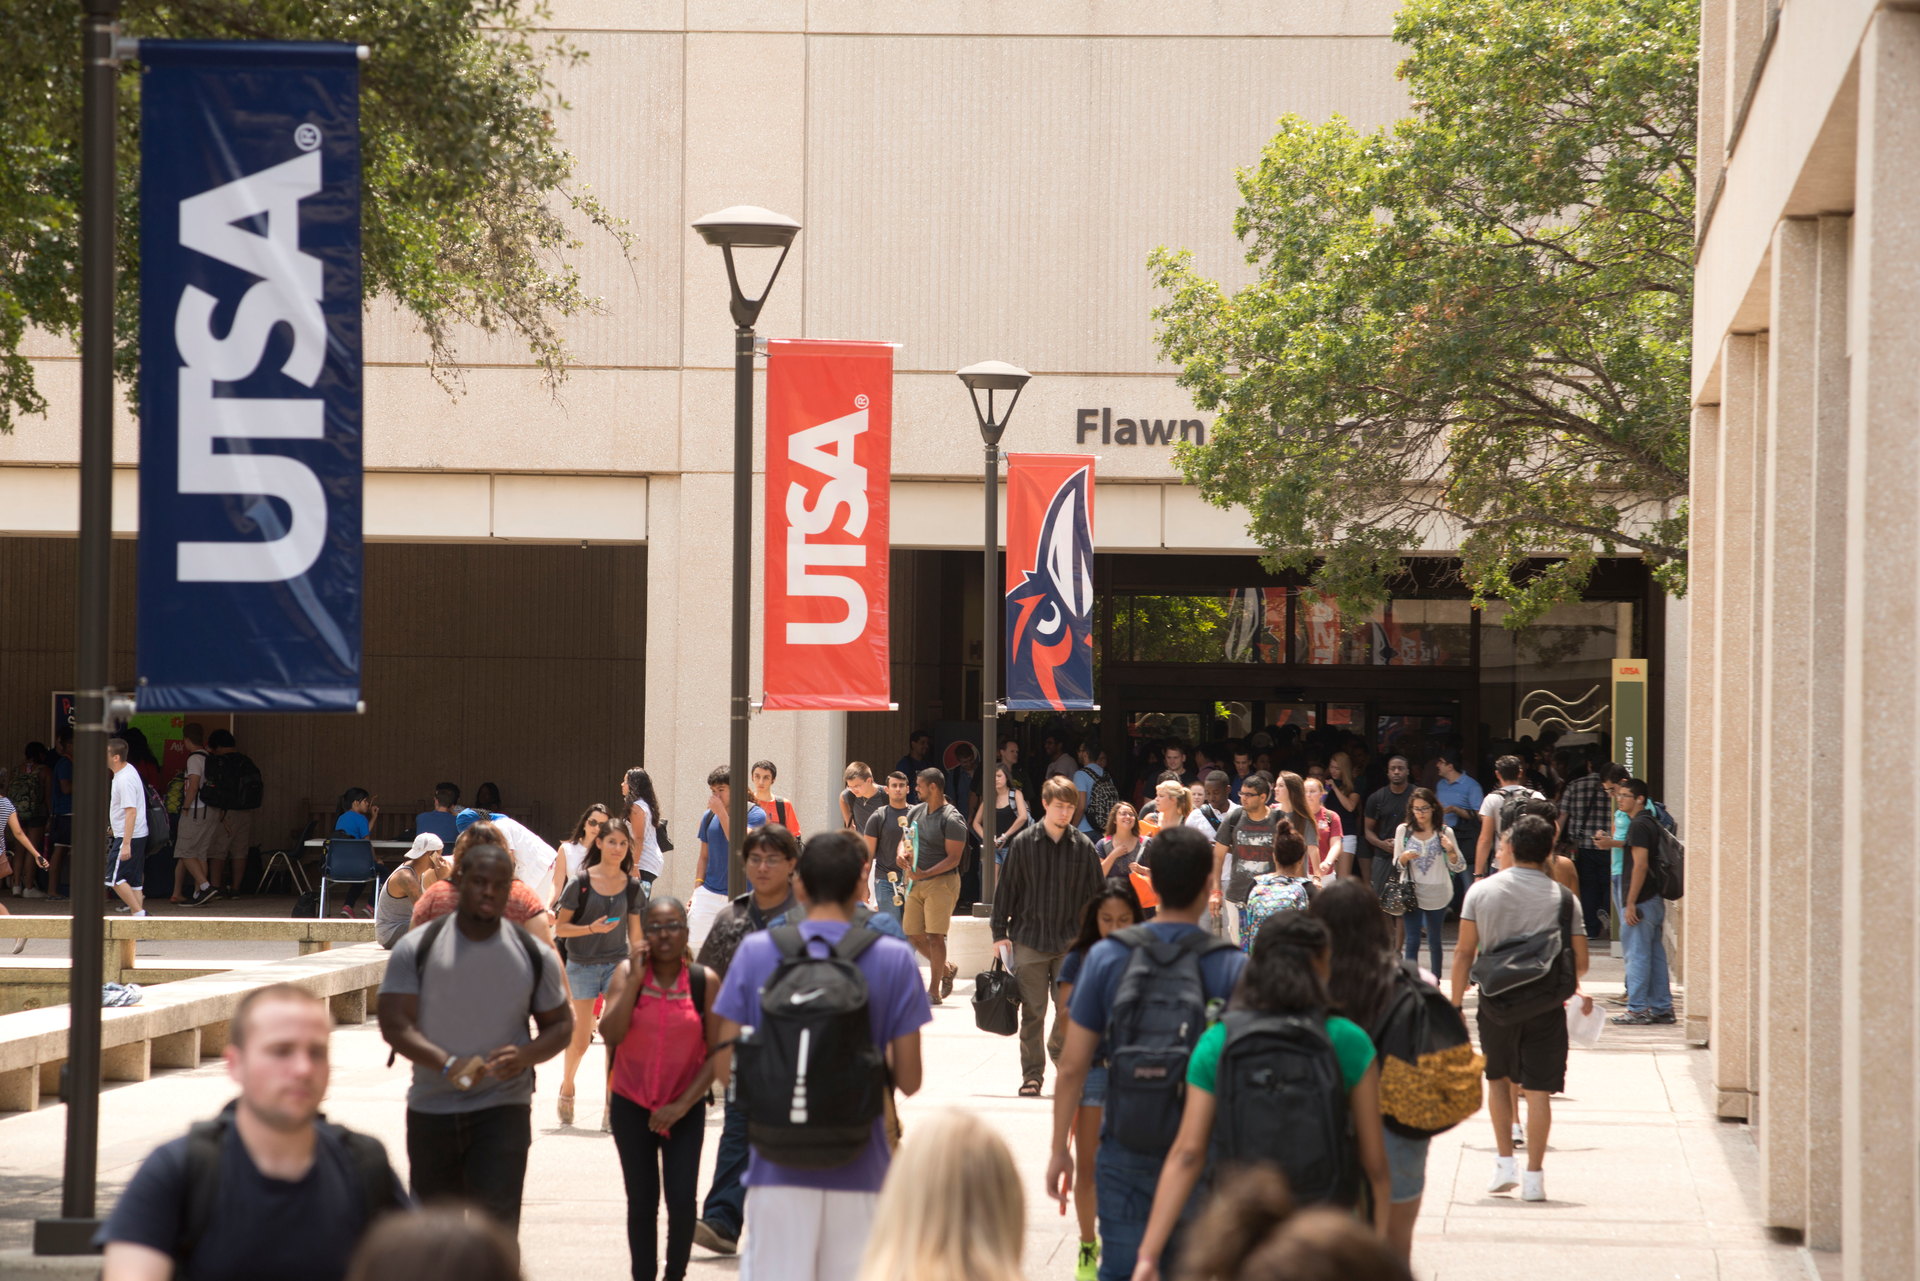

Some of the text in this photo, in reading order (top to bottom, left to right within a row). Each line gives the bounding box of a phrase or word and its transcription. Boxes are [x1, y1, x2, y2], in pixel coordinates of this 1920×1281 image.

[1076, 407, 1205, 446] Flawn
[1619, 667, 1641, 675] UTSA
[169, 741, 185, 754] Ask
